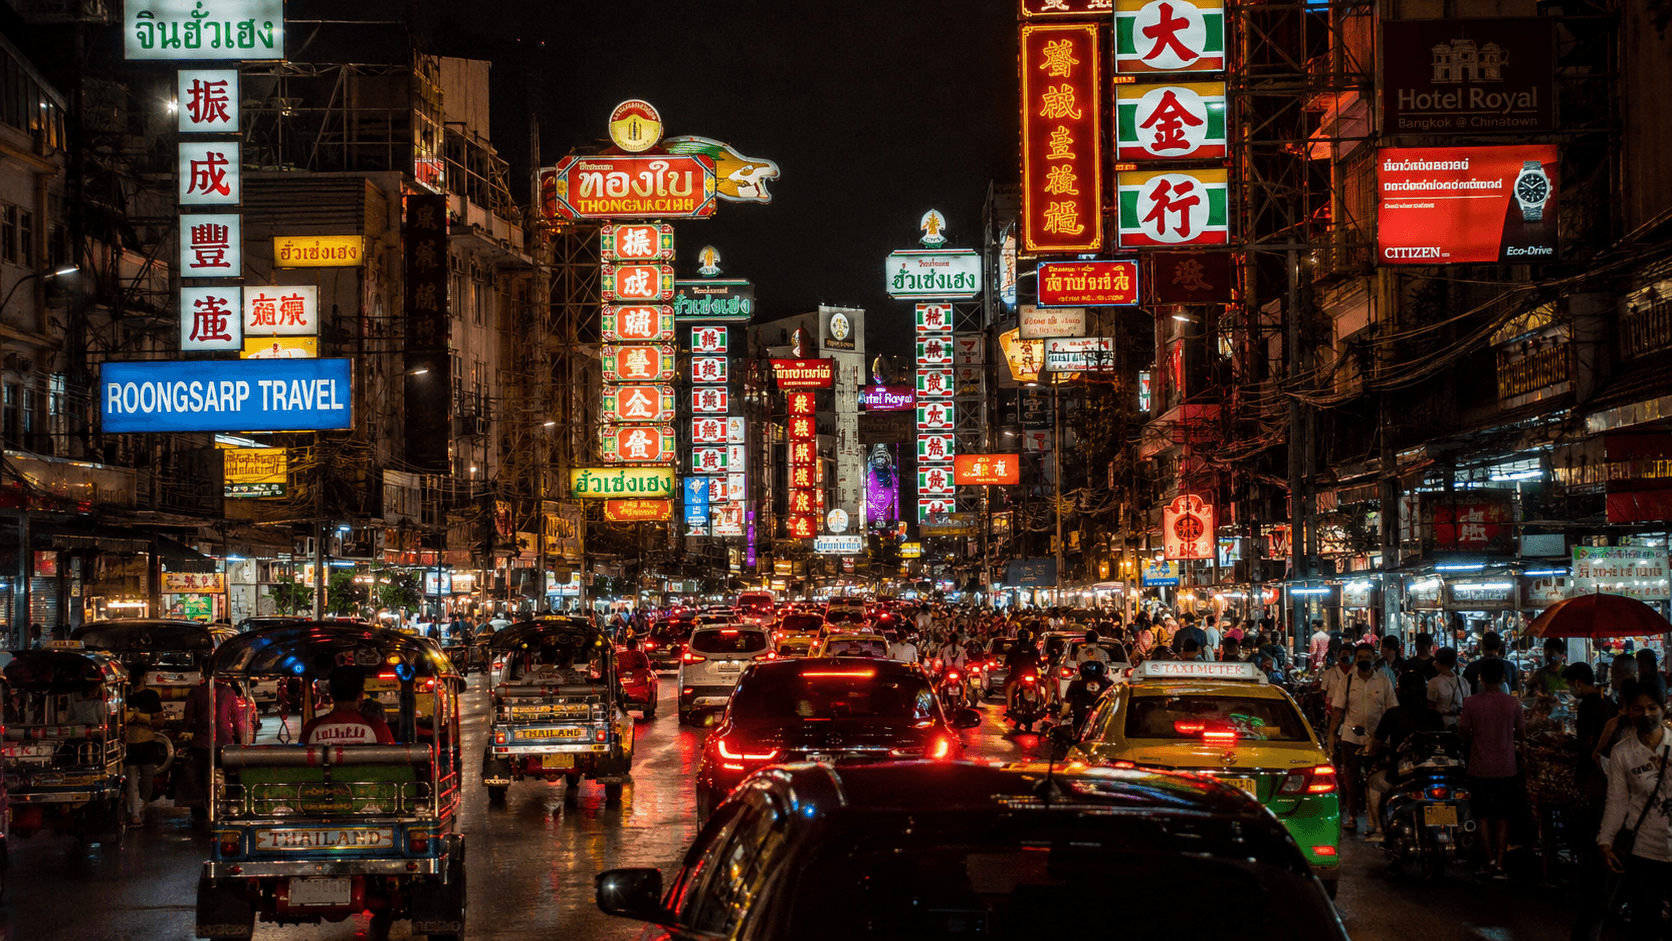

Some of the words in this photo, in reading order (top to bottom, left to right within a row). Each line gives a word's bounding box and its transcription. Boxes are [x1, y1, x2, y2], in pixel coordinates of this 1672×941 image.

[1397, 87, 1462, 110] Hotel
[1469, 86, 1538, 115] Royal
[1140, 2, 1204, 238] 大金行
[1398, 116, 1452, 130] Bangkok
[1471, 116, 1538, 127] Chinatown
[1384, 246, 1441, 259] CITIZEN
[1506, 245, 1553, 256] Eco-Drive
[107, 380, 250, 414] ROONGSARP
[257, 379, 344, 411] TRAVEL
[520, 728, 582, 738] THAILAND
[268, 831, 381, 846] THAILAND
